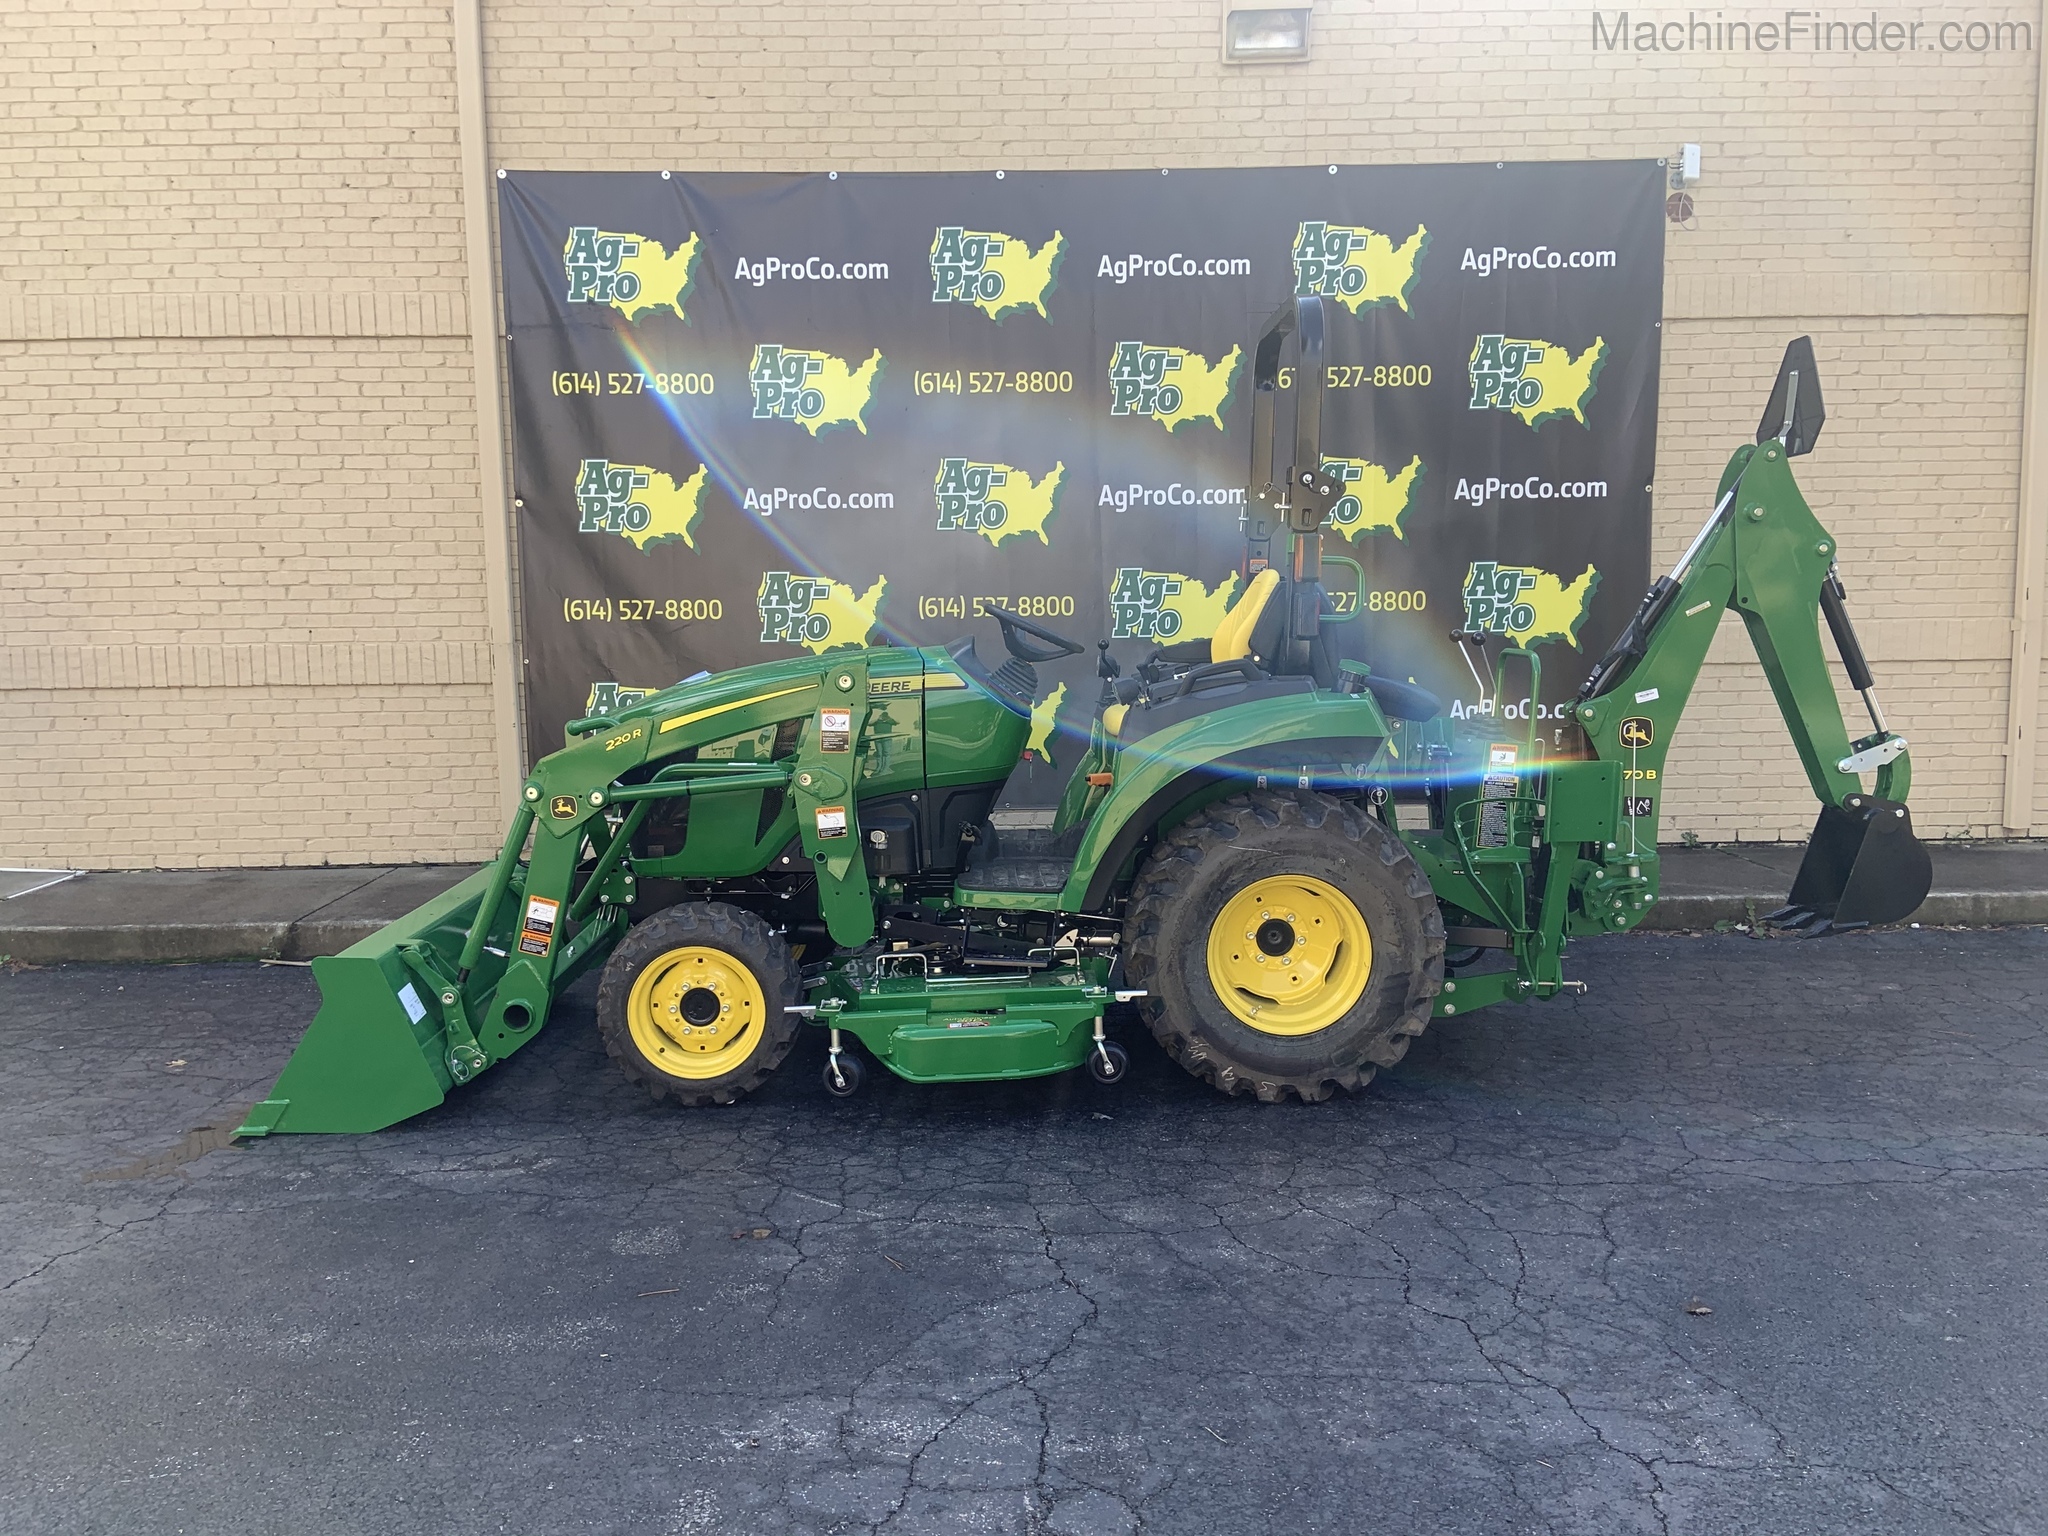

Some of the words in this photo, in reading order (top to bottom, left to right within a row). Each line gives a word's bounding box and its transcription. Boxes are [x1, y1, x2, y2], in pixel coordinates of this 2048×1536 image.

[566, 227, 639, 271] Ag-
[933, 226, 1003, 270] Ag-
[1295, 221, 1367, 266] Ag-
[1460, 246, 1617, 276] AgProCo.com
[567, 264, 640, 302] Pro
[734, 256, 889, 286] AgProCo.com
[932, 264, 1004, 302] Pro
[1097, 253, 1251, 284] AgProCo.com
[1295, 259, 1367, 295] Pro
[752, 344, 823, 388] Ag-
[1110, 341, 1181, 385] Ag-
[1471, 334, 1544, 374] Ag-
[551, 371, 601, 396] (614)
[608, 372, 715, 395] 527-8800
[913, 371, 962, 395] (614)
[969, 371, 1073, 394] 527-8800
[1327, 365, 1432, 388] 527-8800
[1469, 371, 1542, 409] Pro
[752, 381, 824, 418] Pro
[1110, 379, 1182, 415] Pro
[578, 459, 648, 502] Ag-
[936, 458, 1006, 500] Ag-
[1454, 477, 1608, 506] AgProCo.com
[579, 496, 650, 532] Pro
[743, 487, 894, 516] AgProCo.com
[936, 495, 1007, 531] Pro
[1099, 483, 1247, 513] AgProCo.com
[760, 571, 830, 613] Ag-
[1111, 567, 1181, 609] Ag-
[1466, 561, 1536, 604] Ag-
[563, 598, 613, 623] (614)
[619, 599, 723, 620] 527-8800
[918, 595, 966, 620] (614)
[1327, 590, 1427, 612] 278800
[1464, 598, 1536, 633] Pro
[760, 606, 831, 642] Pro
[1111, 603, 1182, 638] Pro
[868, 681, 911, 693] EERE
[605, 733, 632, 752] 220
[632, 728, 642, 739] R
[1623, 770, 1644, 780] 70
[1646, 770, 1657, 780] B
